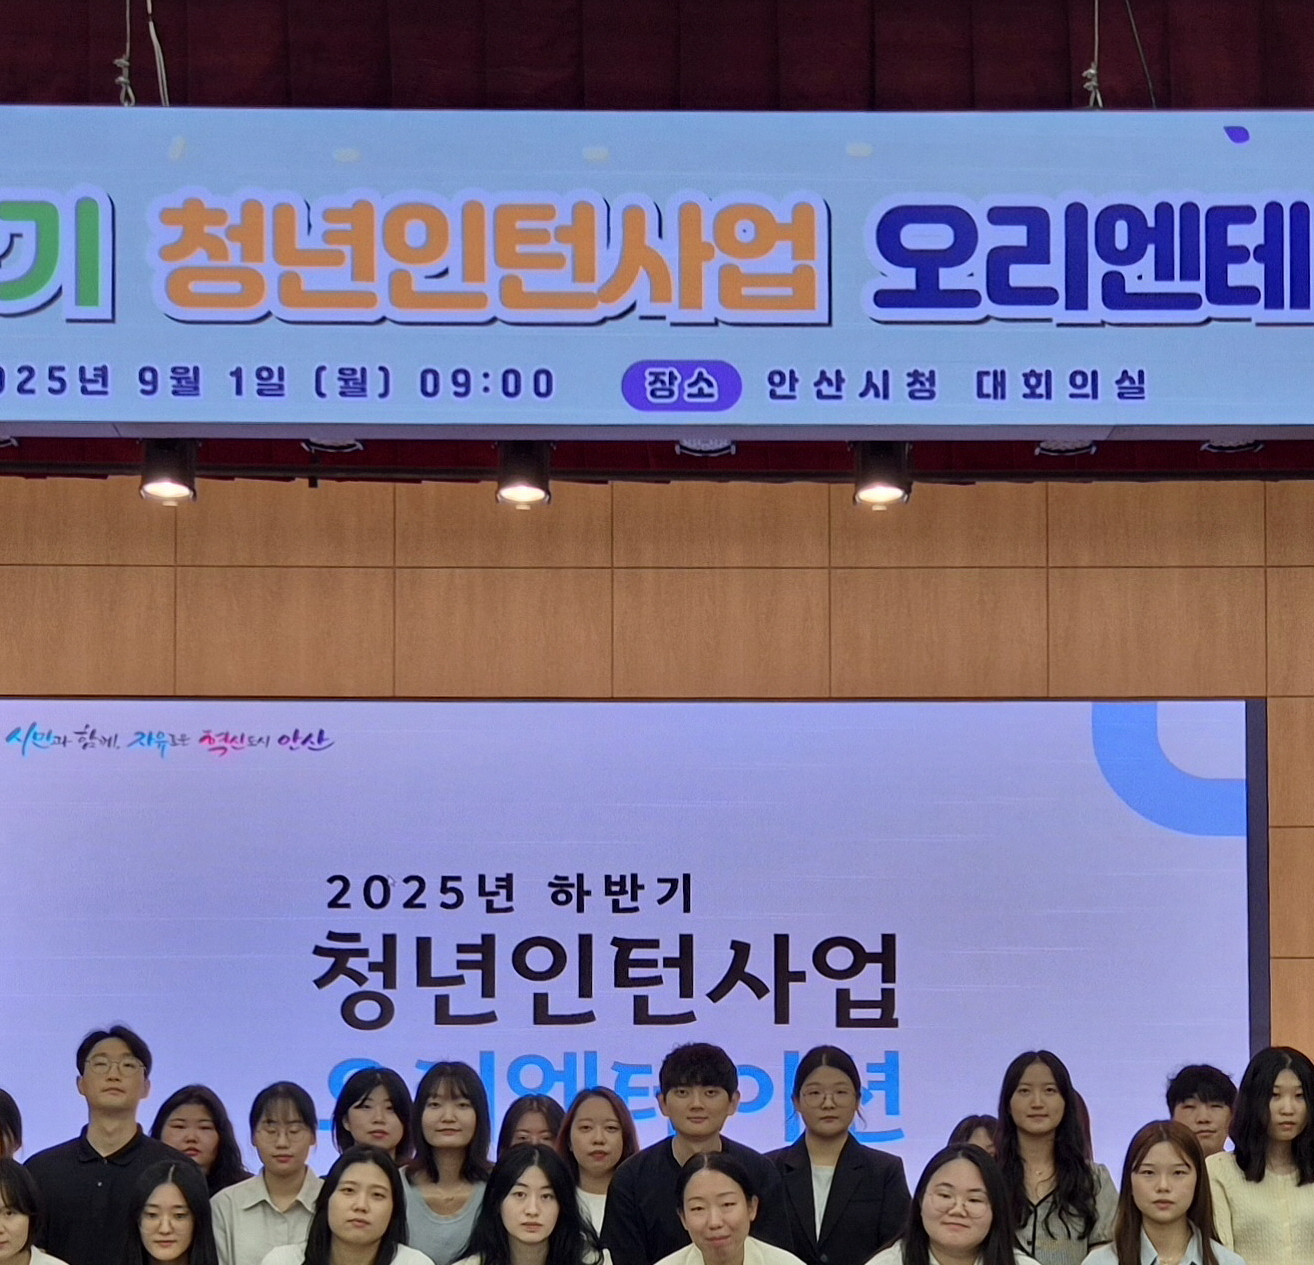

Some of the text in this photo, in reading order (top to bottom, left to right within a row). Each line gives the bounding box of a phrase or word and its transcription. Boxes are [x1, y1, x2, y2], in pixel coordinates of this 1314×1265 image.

[159, 196, 819, 312] 청년인턴사업
[137, 362, 205, 400] 9월
[227, 362, 287, 400] 1일
[312, 362, 397, 402] (월)
[419, 366, 557, 401] 09:00
[645, 368, 718, 402] 장소
[767, 369, 939, 402] 안산시청
[977, 369, 1149, 402] 대회의실
[277, 728, 335, 751] 안산
[325, 873, 696, 916] 2025년 하반기
[312, 931, 899, 1028] 청년인턴사업
